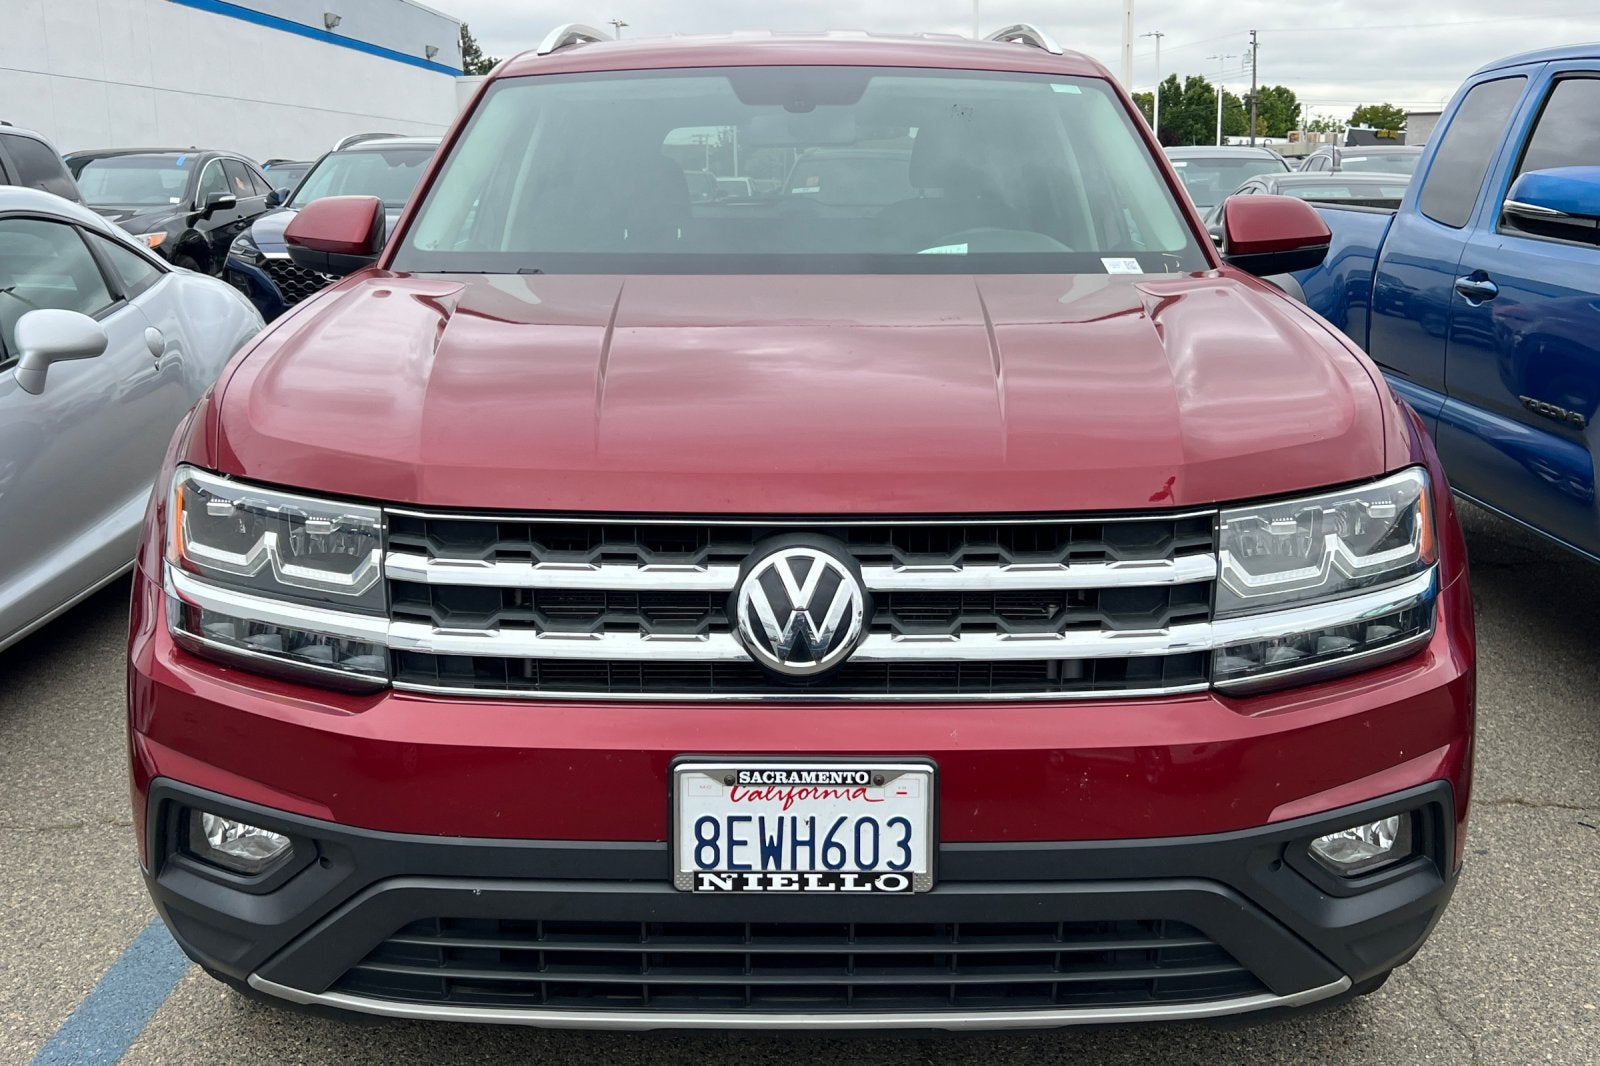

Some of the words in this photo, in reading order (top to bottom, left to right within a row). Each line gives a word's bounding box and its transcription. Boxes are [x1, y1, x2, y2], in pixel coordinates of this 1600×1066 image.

[738, 771, 870, 785] SACRAMENTO
[730, 784, 885, 811] California
[694, 815, 912, 871] 8EWH603
[698, 873, 910, 891] NIELLO
